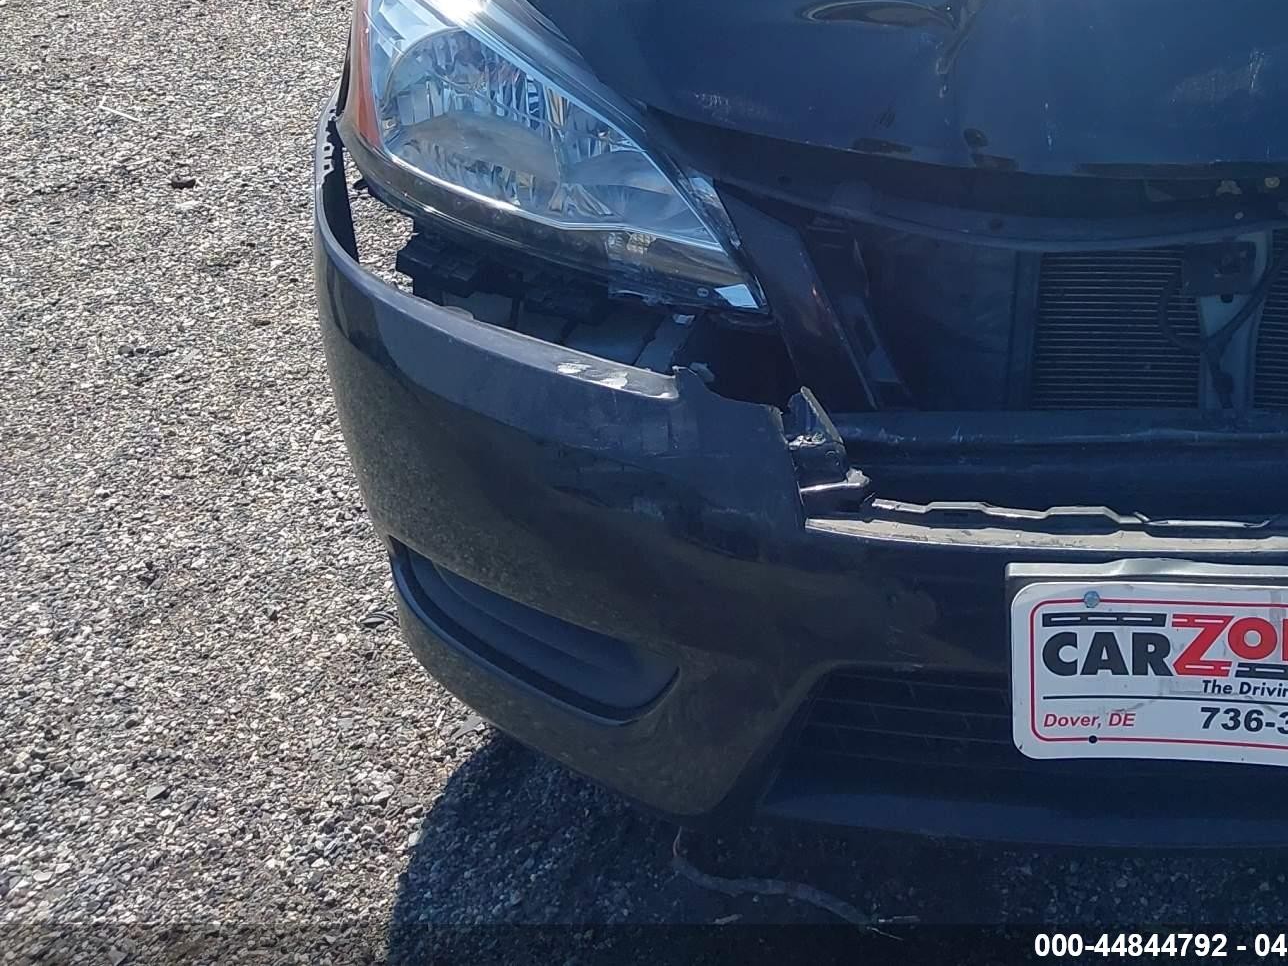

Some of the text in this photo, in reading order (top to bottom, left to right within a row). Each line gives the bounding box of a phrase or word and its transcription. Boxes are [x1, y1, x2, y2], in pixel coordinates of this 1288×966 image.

[1202, 679, 1234, 696] The
[1043, 712, 1136, 730] Dover, DE
